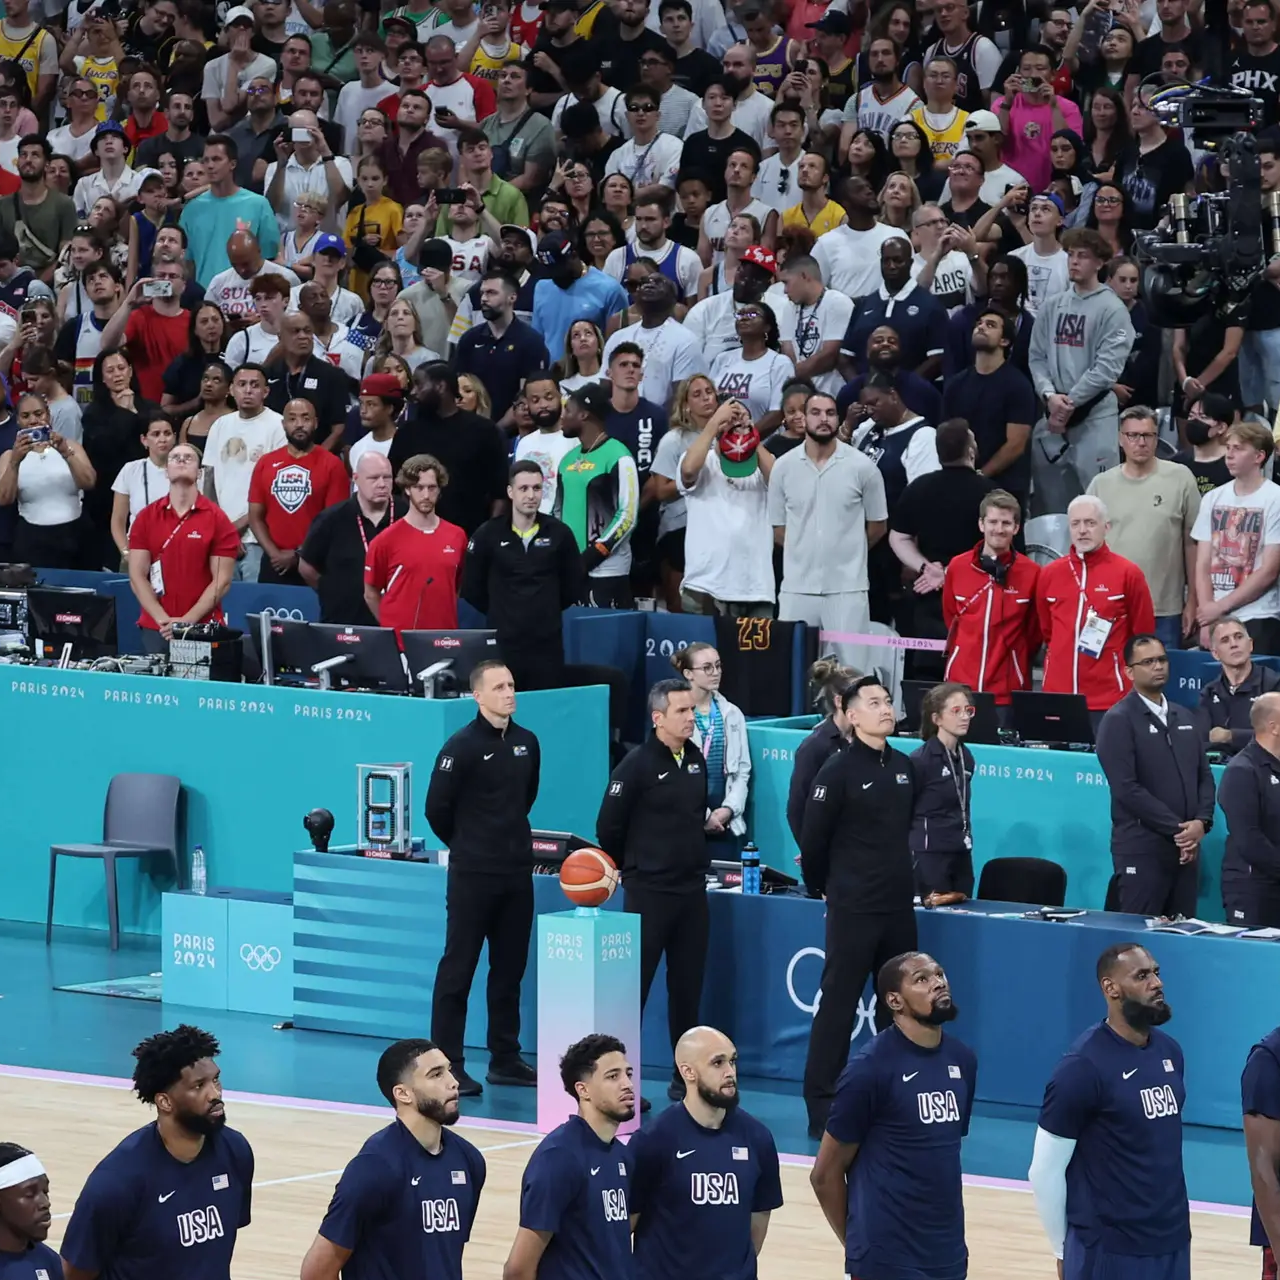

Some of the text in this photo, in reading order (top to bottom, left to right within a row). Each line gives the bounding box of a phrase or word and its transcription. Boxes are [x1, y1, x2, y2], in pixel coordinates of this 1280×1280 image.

[1231, 70, 1279, 93] PHX
[451, 255, 483, 272] SA
[934, 269, 966, 293] ARIS
[1055, 312, 1087, 338] USA
[718, 371, 754, 392] USA
[281, 473, 304, 485] USA
[343, 634, 361, 642] OMEGA
[736, 616, 771, 650] 23
[51, 684, 86, 699] 2024
[145, 692, 180, 707] 2024
[240, 700, 275, 715] 2024
[336, 706, 372, 722] 2024
[1015, 767, 1054, 783] 2024
[174, 950, 215, 969] 2024
[547, 945, 584, 962] 2024
[601, 946, 632, 962] 2024
[916, 1089, 960, 1125] USA
[1140, 1084, 1178, 1119] USA
[691, 1172, 740, 1206] USA
[420, 1196, 461, 1234] USA
[601, 1187, 628, 1223] USA
[176, 1204, 225, 1248] USA
